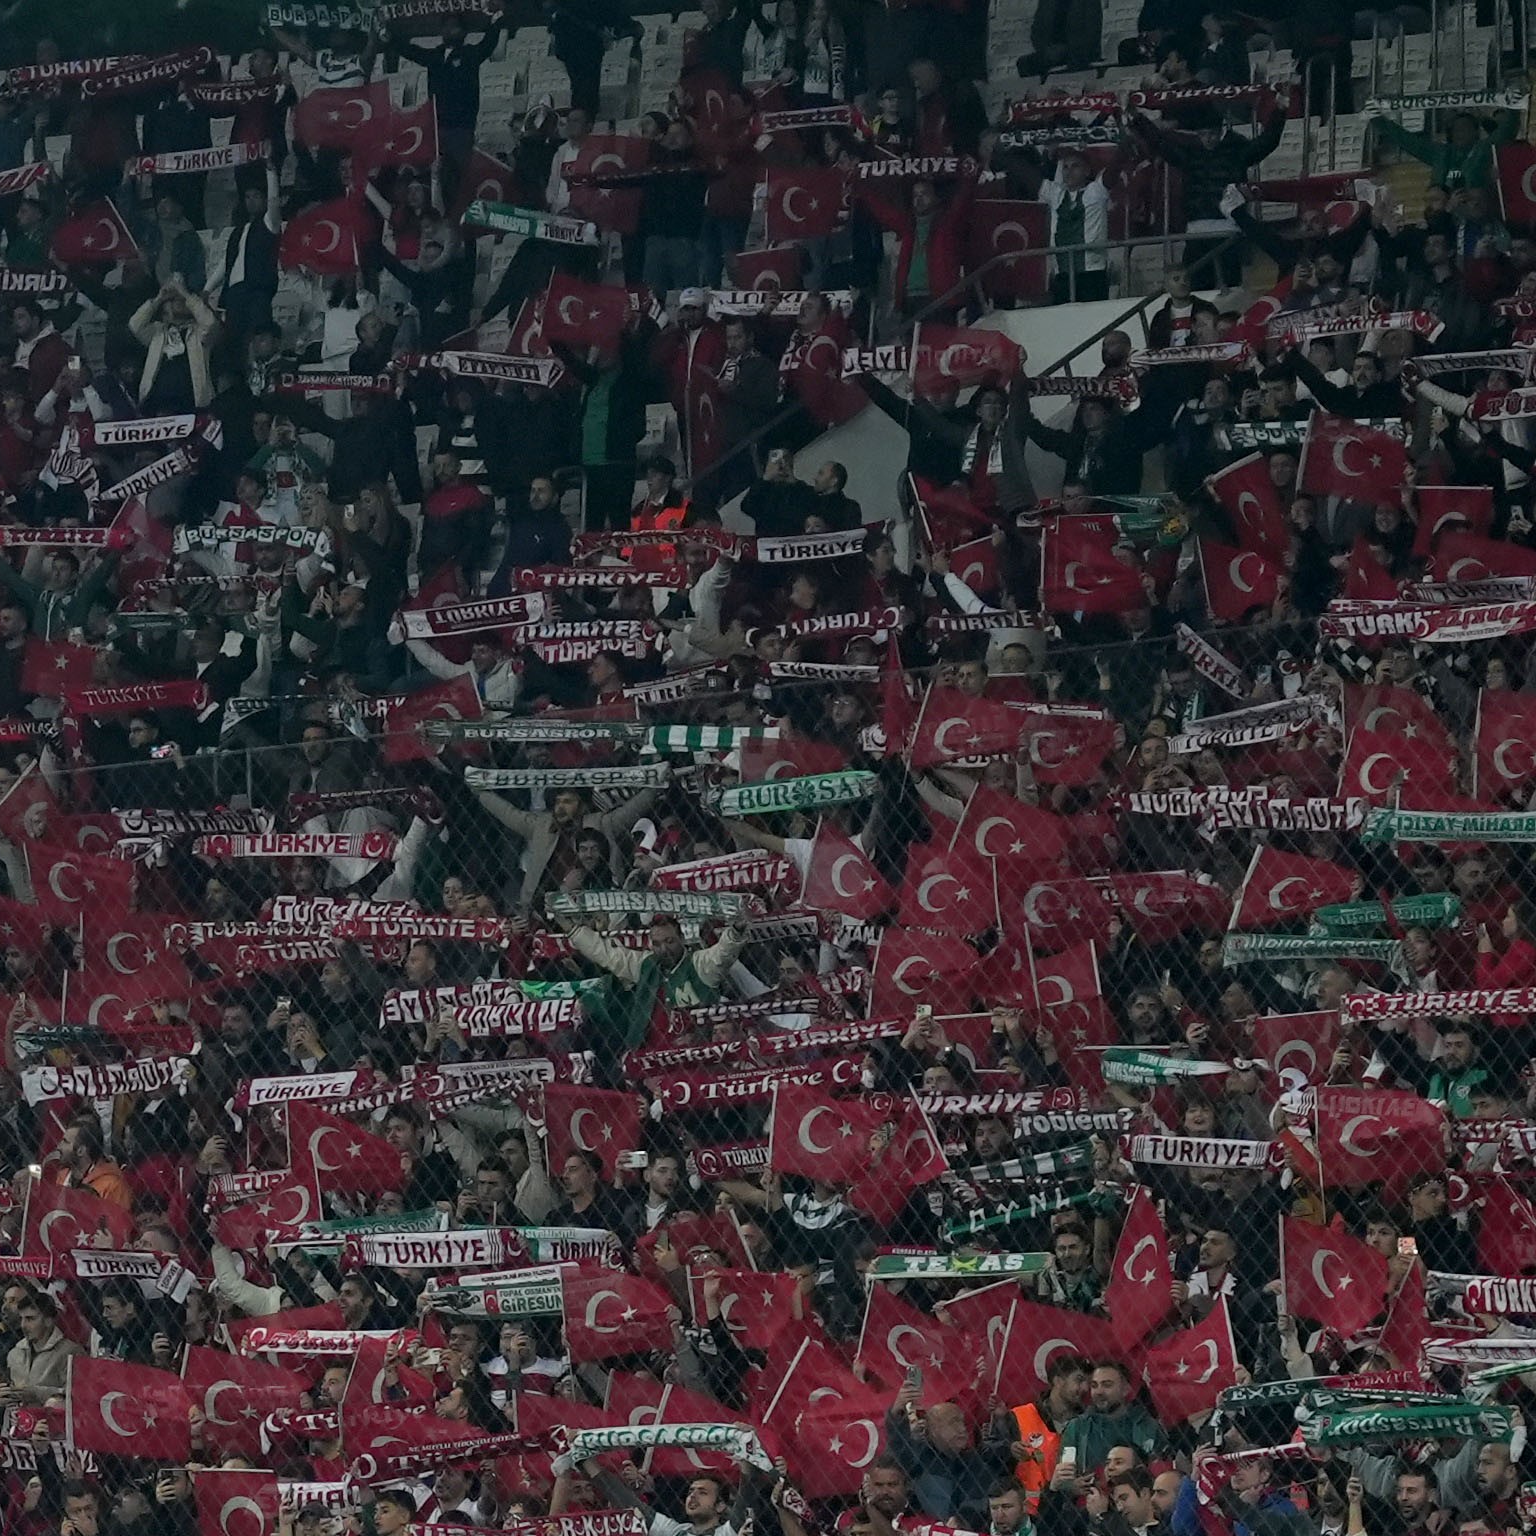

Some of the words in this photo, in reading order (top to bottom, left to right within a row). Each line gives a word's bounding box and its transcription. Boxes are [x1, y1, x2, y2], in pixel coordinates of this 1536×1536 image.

[858, 158, 958, 179] TÜRKİYE
[102, 424, 190, 441] TÜRKİYE
[111, 453, 181, 500] TÜRKİYE
[765, 539, 863, 558] TÜRKİYE
[539, 572, 662, 586] TÜRKİYE
[81, 686, 165, 706] TÜRKİYE
[245, 834, 351, 854] TÜRKİYE
[362, 918, 478, 938] TÜRKİYE
[1378, 991, 1522, 1011] TÜRKİYE
[256, 1080, 346, 1099] TÜRKİYE
[1149, 1138, 1252, 1162] TÜRKİYE
[378, 1241, 485, 1264] TÜRKİYE
